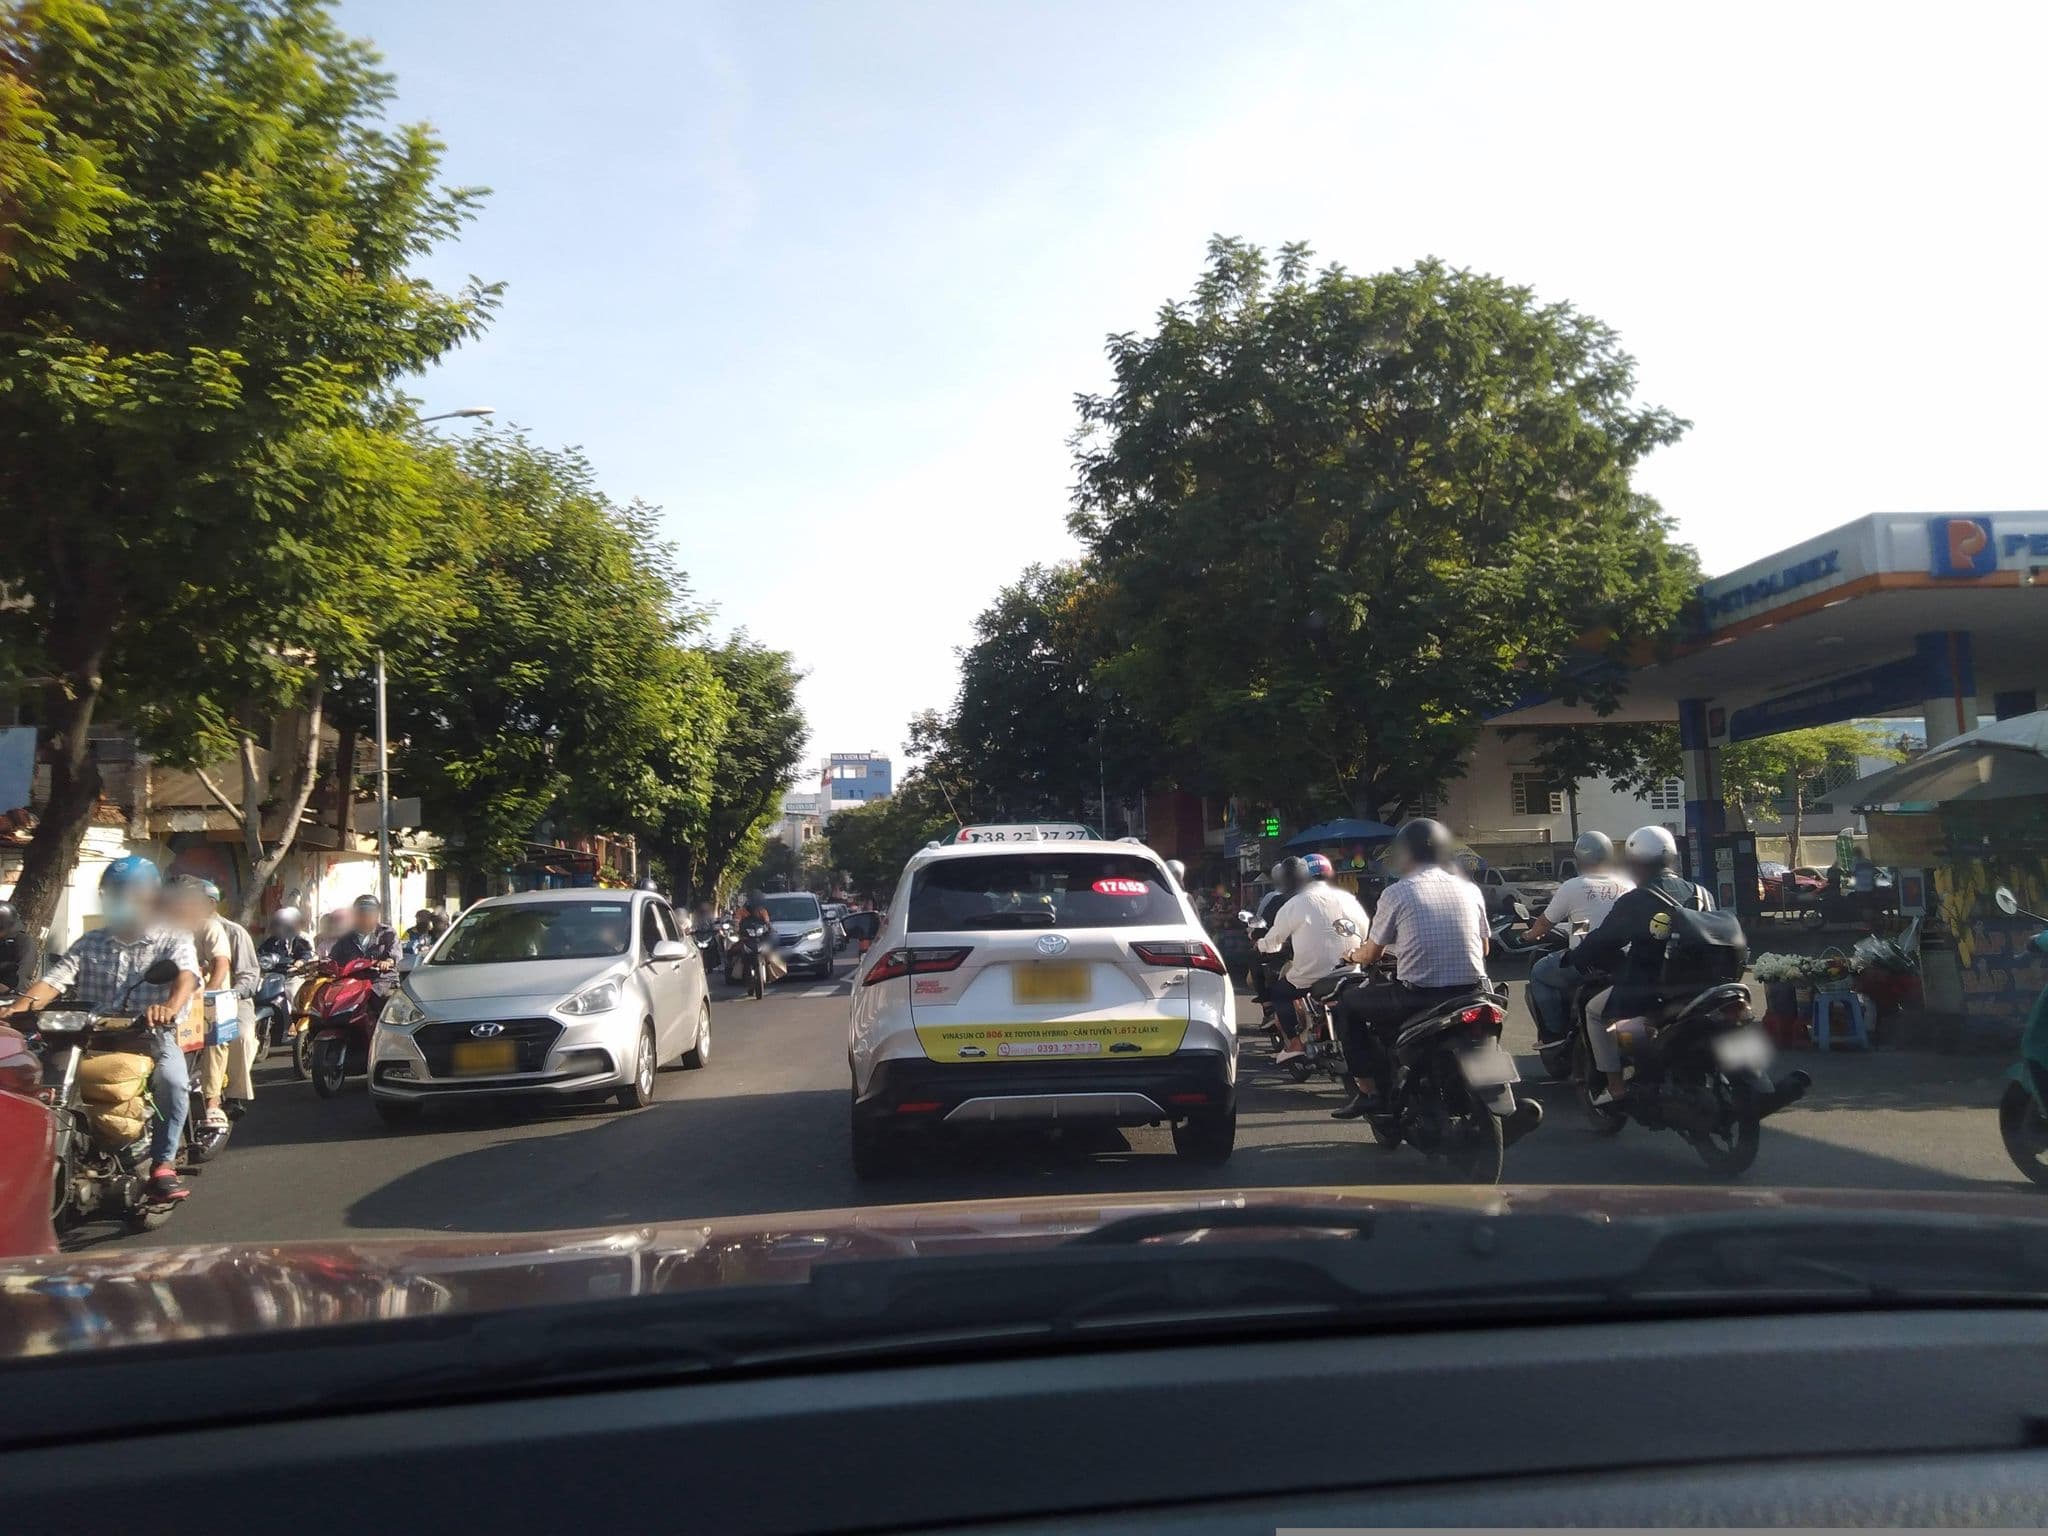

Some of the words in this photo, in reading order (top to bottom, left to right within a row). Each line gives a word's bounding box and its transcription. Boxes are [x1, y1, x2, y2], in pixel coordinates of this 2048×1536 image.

[942, 1031, 974, 1040] VINASUN
[1014, 1030, 1041, 1038] TOYOTA
[1042, 1028, 1069, 1037] HYBRID
[1037, 1044, 1059, 1053] 0393
